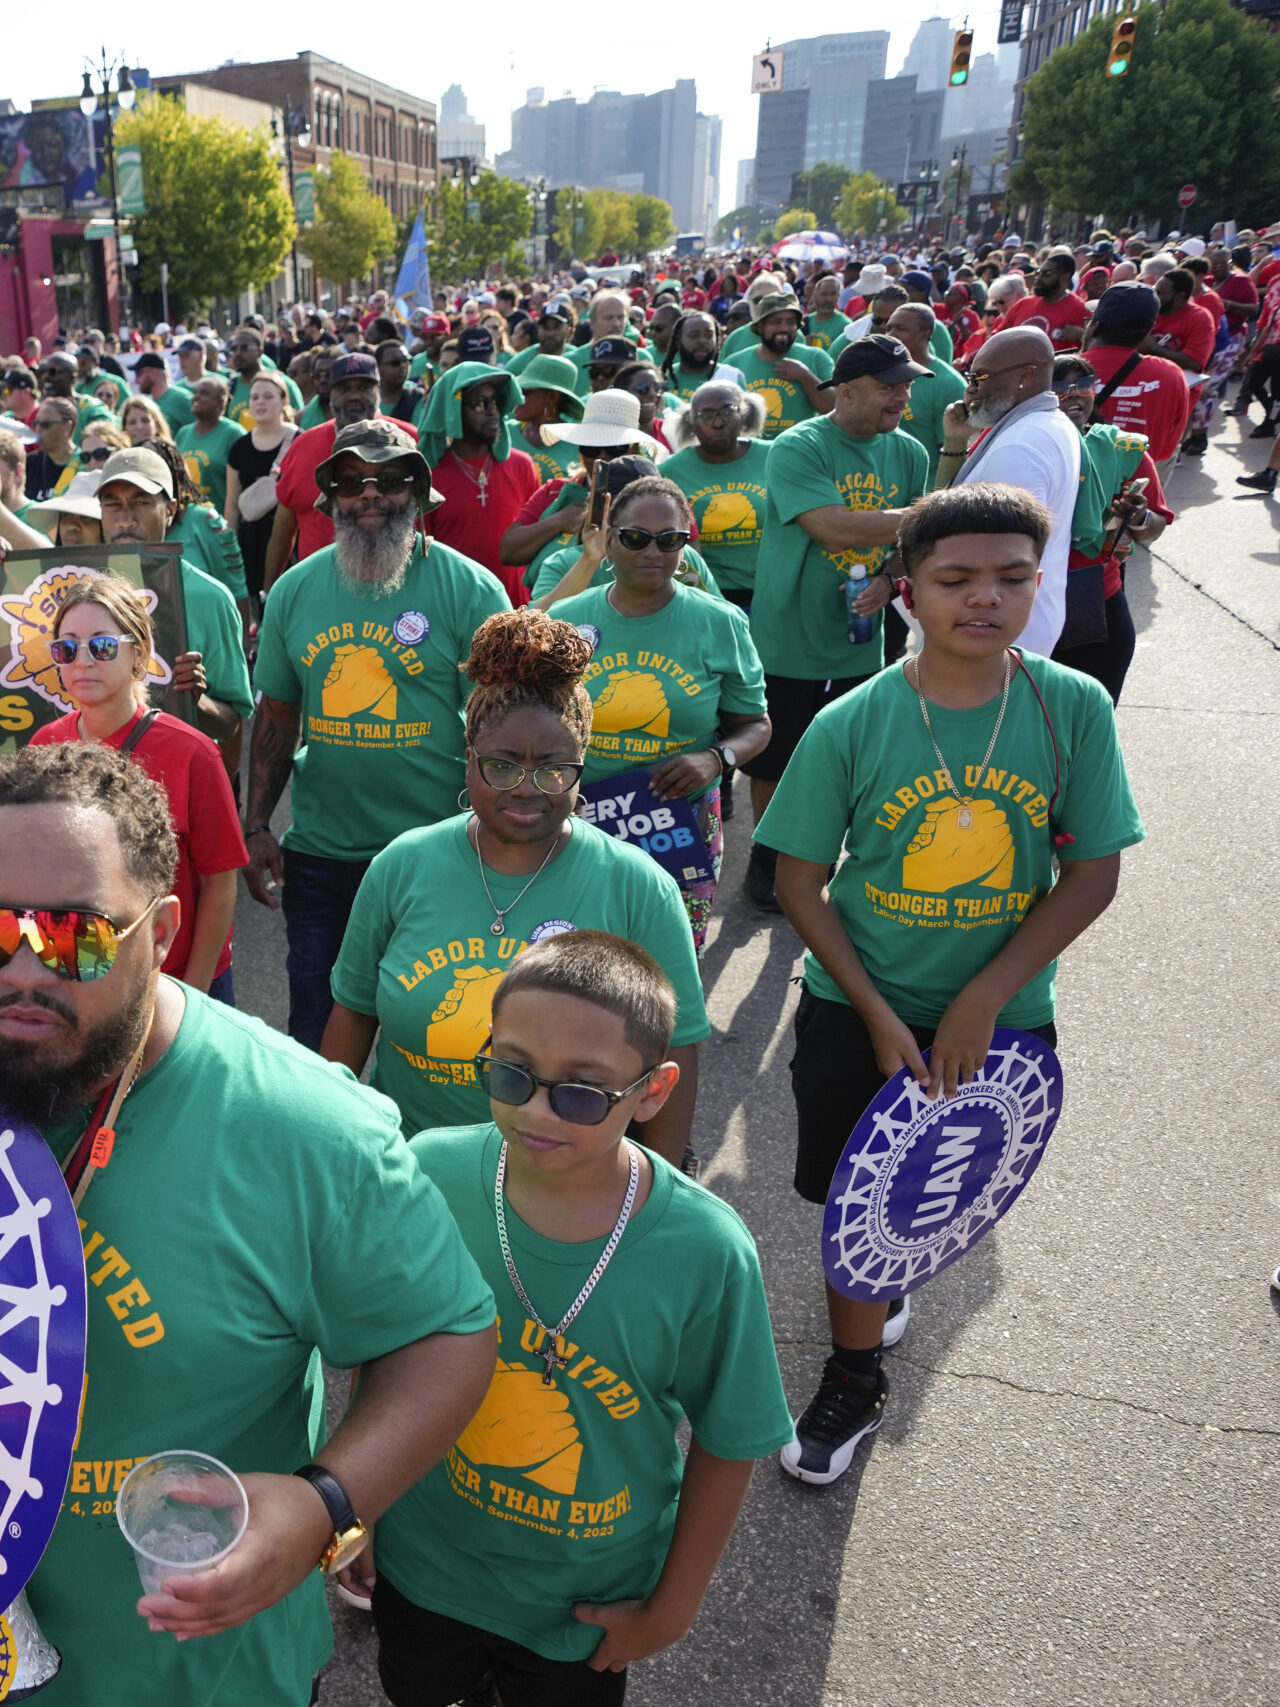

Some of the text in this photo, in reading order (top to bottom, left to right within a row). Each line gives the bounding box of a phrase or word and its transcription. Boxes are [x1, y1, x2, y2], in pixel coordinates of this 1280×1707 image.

[1002, 2, 1019, 39] THE
[755, 80, 778, 90] ONLY
[835, 472, 899, 498] LOCAL 7
[399, 619, 421, 637] STRIKE
[300, 622, 354, 668] LABOR
[362, 621, 424, 676] UNITED
[637, 651, 701, 696] UNITED
[334, 738, 354, 746] March
[355, 740, 394, 748] September
[405, 739, 420, 747] 2023
[355, 723, 391, 739] THAN
[395, 721, 431, 739] EVER!
[623, 753, 659, 762] September
[624, 738, 661, 753] THAN
[875, 765, 1049, 831] LABOR UNITED
[613, 807, 675, 841] JOB
[864, 881, 948, 917] STRONGER
[954, 896, 1002, 918] THAN
[531, 920, 574, 940] UAW REGION
[874, 906, 896, 920] Labor
[898, 915, 915, 928] Day
[918, 919, 950, 928] March
[953, 917, 1004, 931] September
[397, 938, 486, 992] LABOR
[395, 1046, 476, 1081] RONGER
[430, 1074, 449, 1086] Day
[955, 1085, 994, 1097] WORKERS
[995, 1088, 1005, 1096] OF
[902, 1098, 950, 1141] IMPLEMENT
[1005, 1095, 1021, 1124] AMERICA
[871, 1144, 902, 1214] AGRICULTURAL
[910, 1126, 982, 1228] UAW
[961, 1195, 989, 1225] UNITED
[869, 1217, 877, 1234] AND
[872, 1235, 904, 1257] AEROSPACE
[78, 1217, 165, 1349] ITED
[520, 1318, 640, 1419] UNITED
[71, 1502, 86, 1517] 4,
[450, 1480, 615, 1540] March September 4, 2023
[489, 1480, 560, 1522] THAN
[568, 1484, 632, 1524] EVER!
